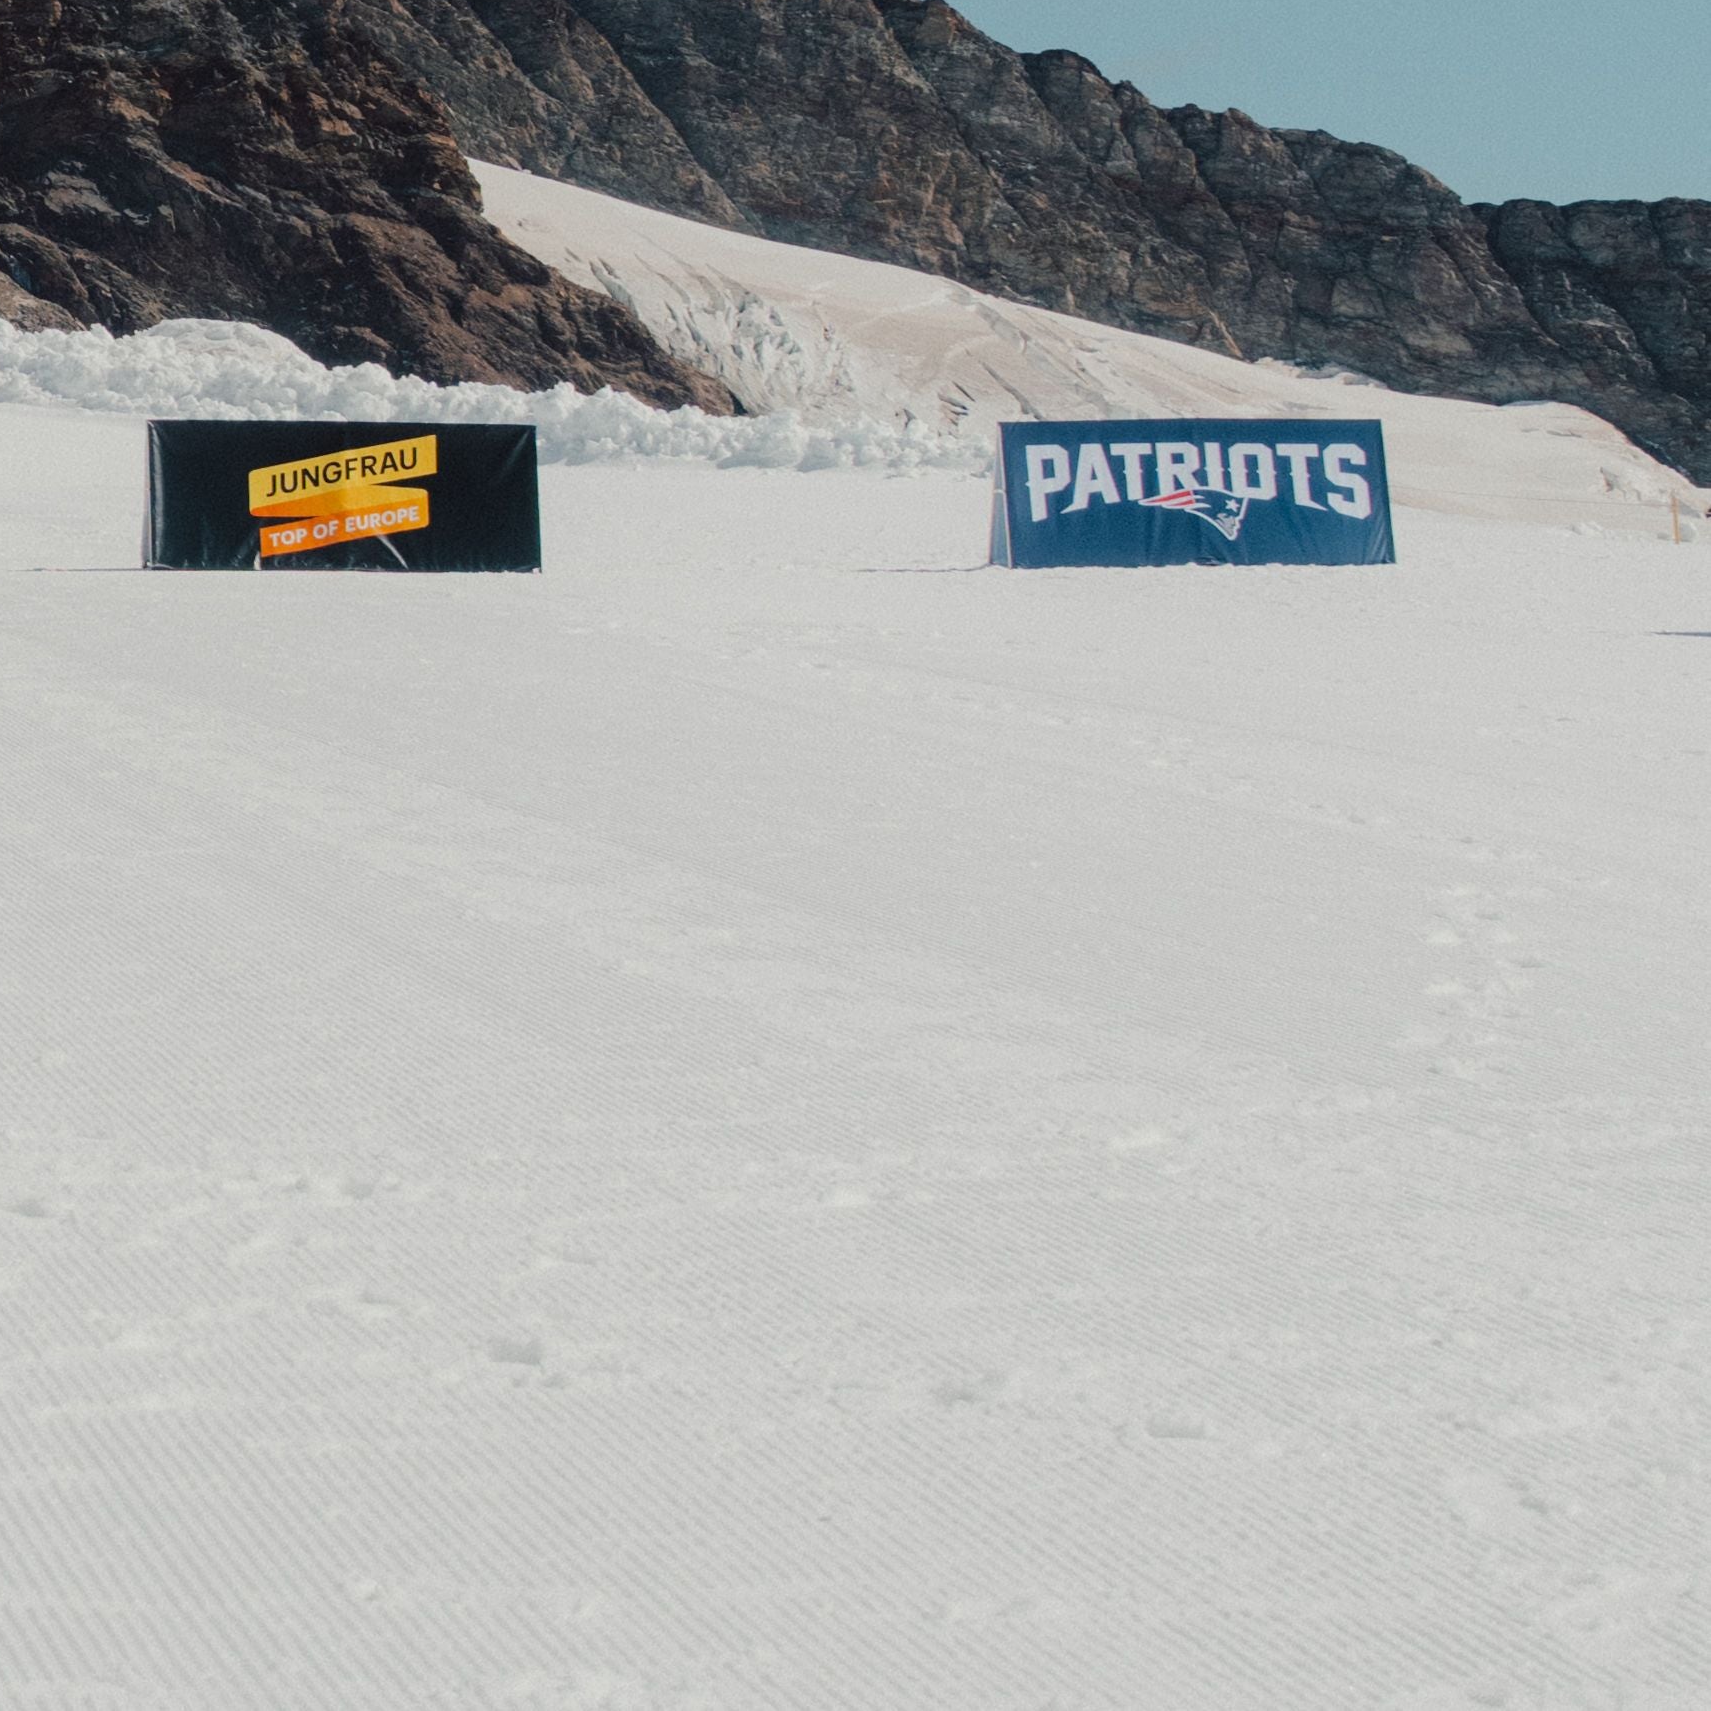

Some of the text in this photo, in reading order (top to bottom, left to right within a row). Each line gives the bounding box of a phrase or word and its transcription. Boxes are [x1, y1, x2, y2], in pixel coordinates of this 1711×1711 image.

[266, 447, 418, 497] JUNGFRAU
[1025, 442, 1373, 522] PATRIOTS
[269, 506, 420, 548] TOP OF EUROPE
